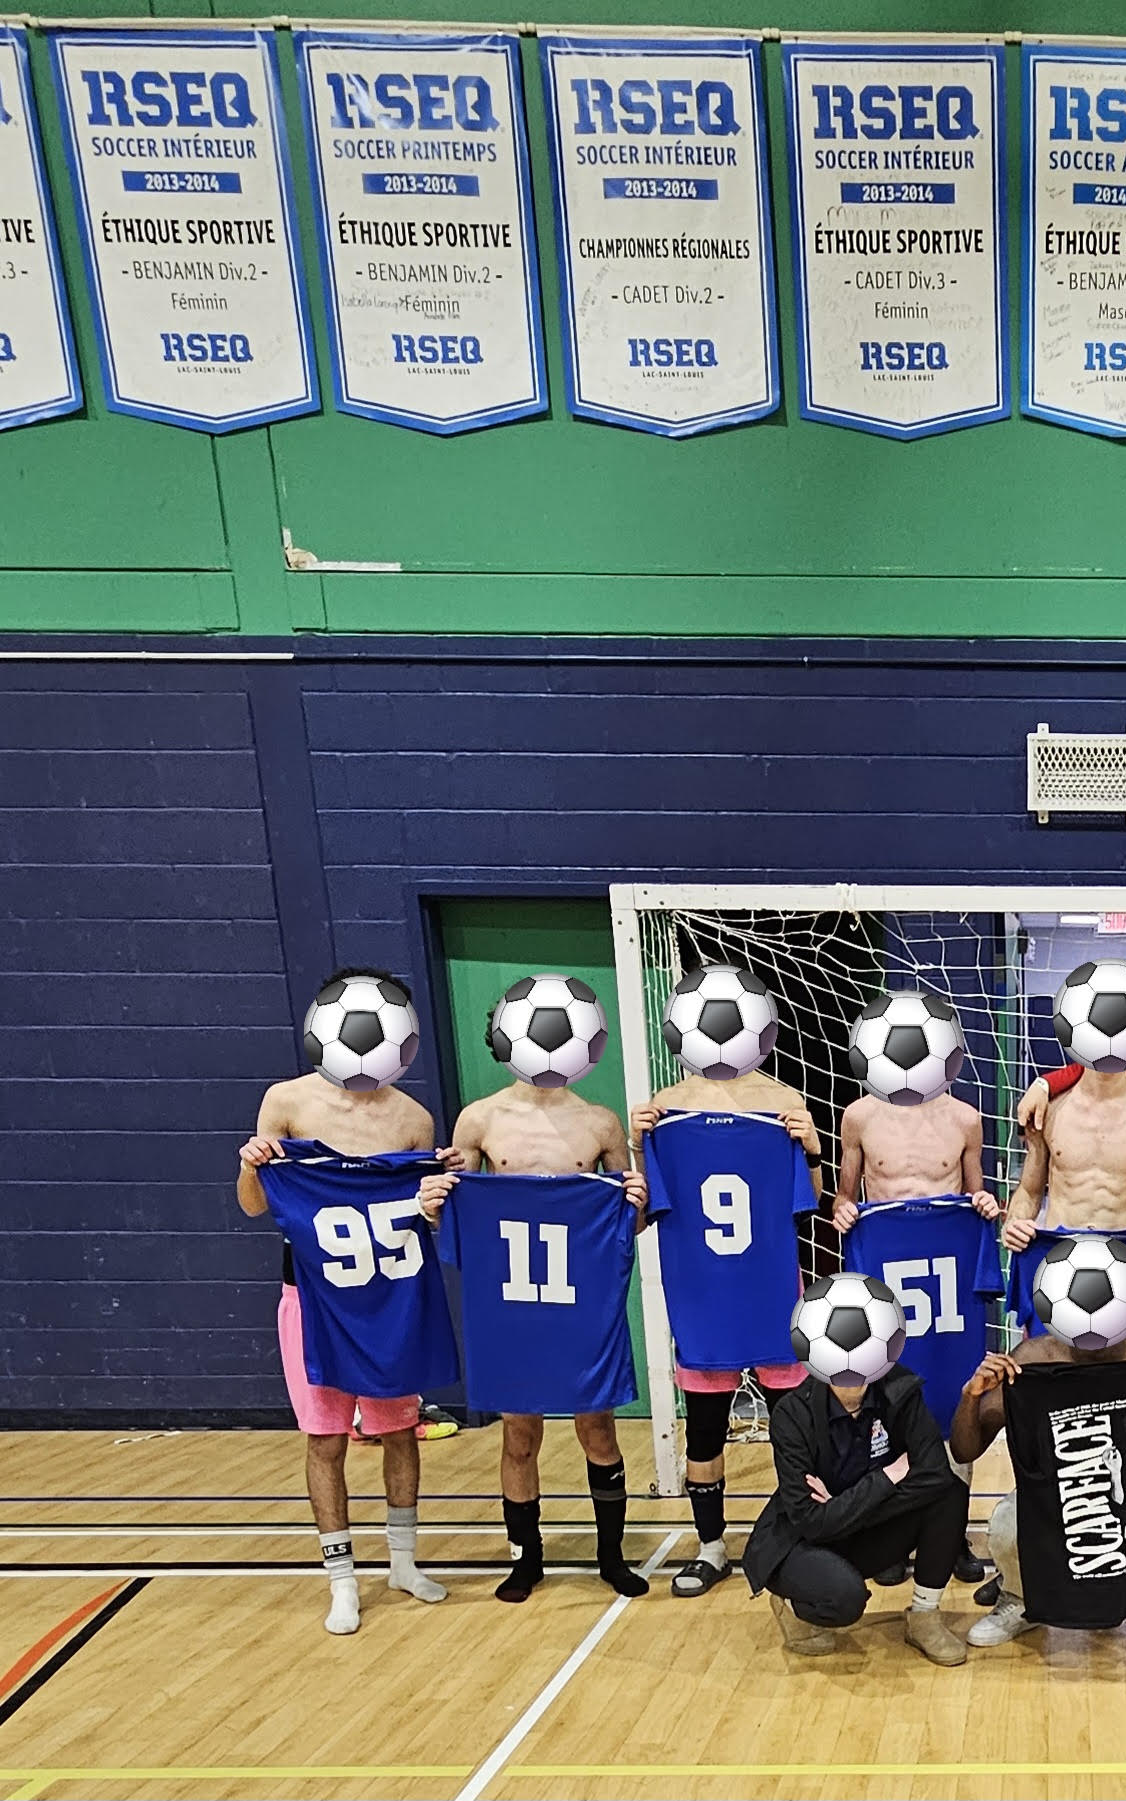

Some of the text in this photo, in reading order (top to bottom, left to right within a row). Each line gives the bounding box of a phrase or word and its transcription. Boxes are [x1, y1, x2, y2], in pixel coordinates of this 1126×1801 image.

[81, 71, 258, 128] RSEQ
[327, 73, 499, 132] RSEQ
[571, 79, 741, 136] RSEQ
[812, 85, 980, 140] RSEQ
[92, 133, 256, 158] SOCCER INTÉRIEUR
[333, 139, 496, 162] SOCCER PRINTEMPS
[577, 140, 737, 166] SOCCER INTÉRIEUR
[815, 145, 974, 170] SOCCER INTÉRIEUR
[1050, 151, 1115, 172] SOCCER
[145, 174, 219, 190] 2013-2014
[384, 176, 456, 193] 2013-2014
[625, 181, 696, 197] 2013-2014
[863, 185, 933, 201] 2013-2014
[102, 211, 275, 245] ÉTHIQUE SPORTIVE
[338, 212, 511, 248] ÉTHIQUE SPORTIVE
[815, 222, 983, 256] ÉTHIQUE SPORTIVE
[1046, 222, 1120, 256] ÉTHIQUE
[579, 232, 749, 259] CHAMPIONNES RÉGIONALES
[133, 261, 214, 280] BENJAMIN
[219, 262, 257, 280] Div.2
[368, 263, 447, 282] BENJAMIN
[453, 265, 490, 283] Div.2
[856, 271, 902, 289] CADET
[909, 270, 945, 290] Div.3
[171, 293, 227, 310] Féminin
[404, 295, 460, 313] Féminin
[623, 285, 669, 304] CADET
[676, 285, 712, 304] Div.2
[875, 302, 928, 319] Féminin
[160, 334, 253, 362] RSEQ
[392, 334, 484, 364] RSEQ
[628, 339, 718, 367] RSEQ
[860, 342, 949, 370] RSEQ
[700, 1174, 752, 1255] 9
[313, 1197, 424, 1288] 95
[500, 1220, 576, 1304] 11
[882, 1256, 965, 1337] 51
[1052, 1414, 1126, 1574] SCARFACE
